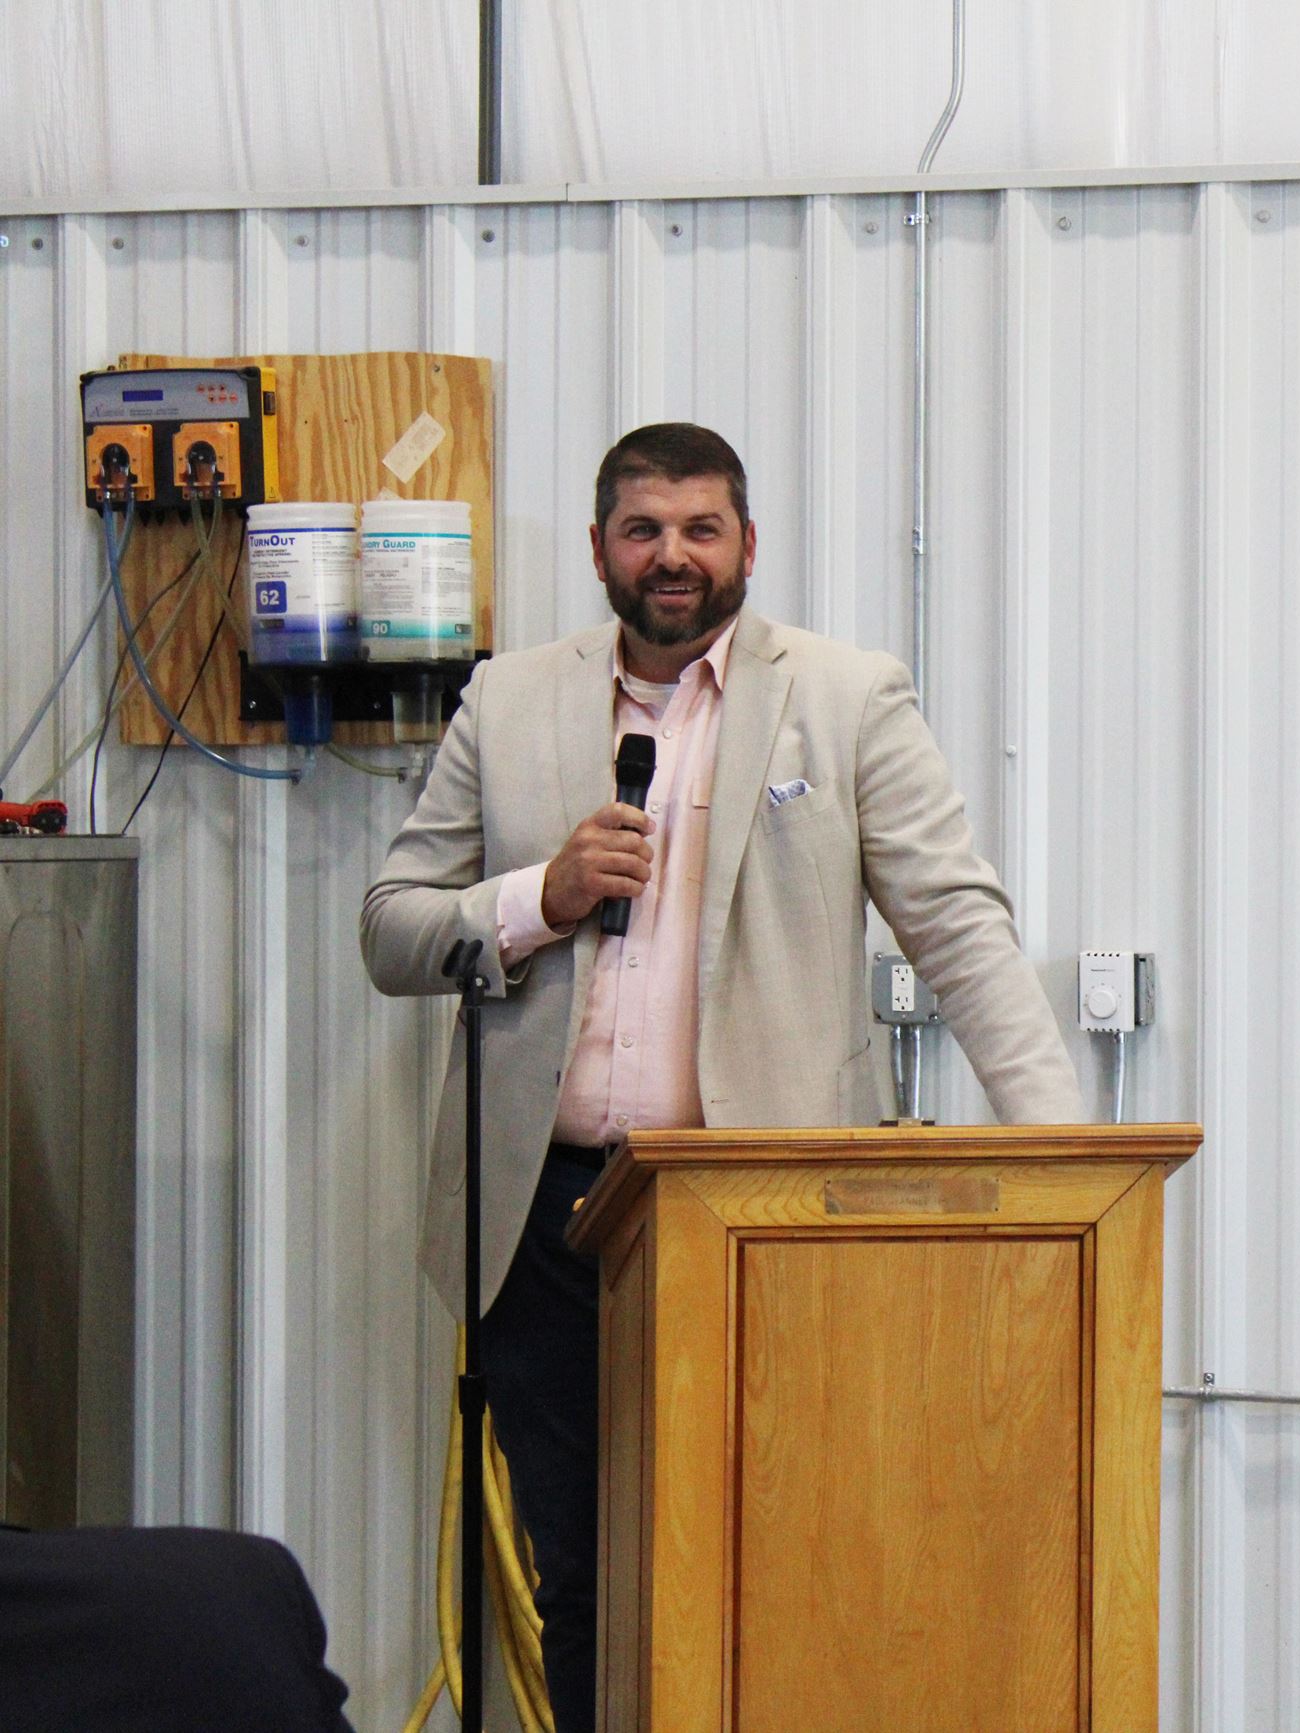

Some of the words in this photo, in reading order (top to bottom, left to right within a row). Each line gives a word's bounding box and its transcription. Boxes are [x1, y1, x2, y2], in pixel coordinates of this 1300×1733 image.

[383, 539, 416, 549] GUARD
[260, 589, 280, 606] 62
[372, 623, 389, 635] 90
